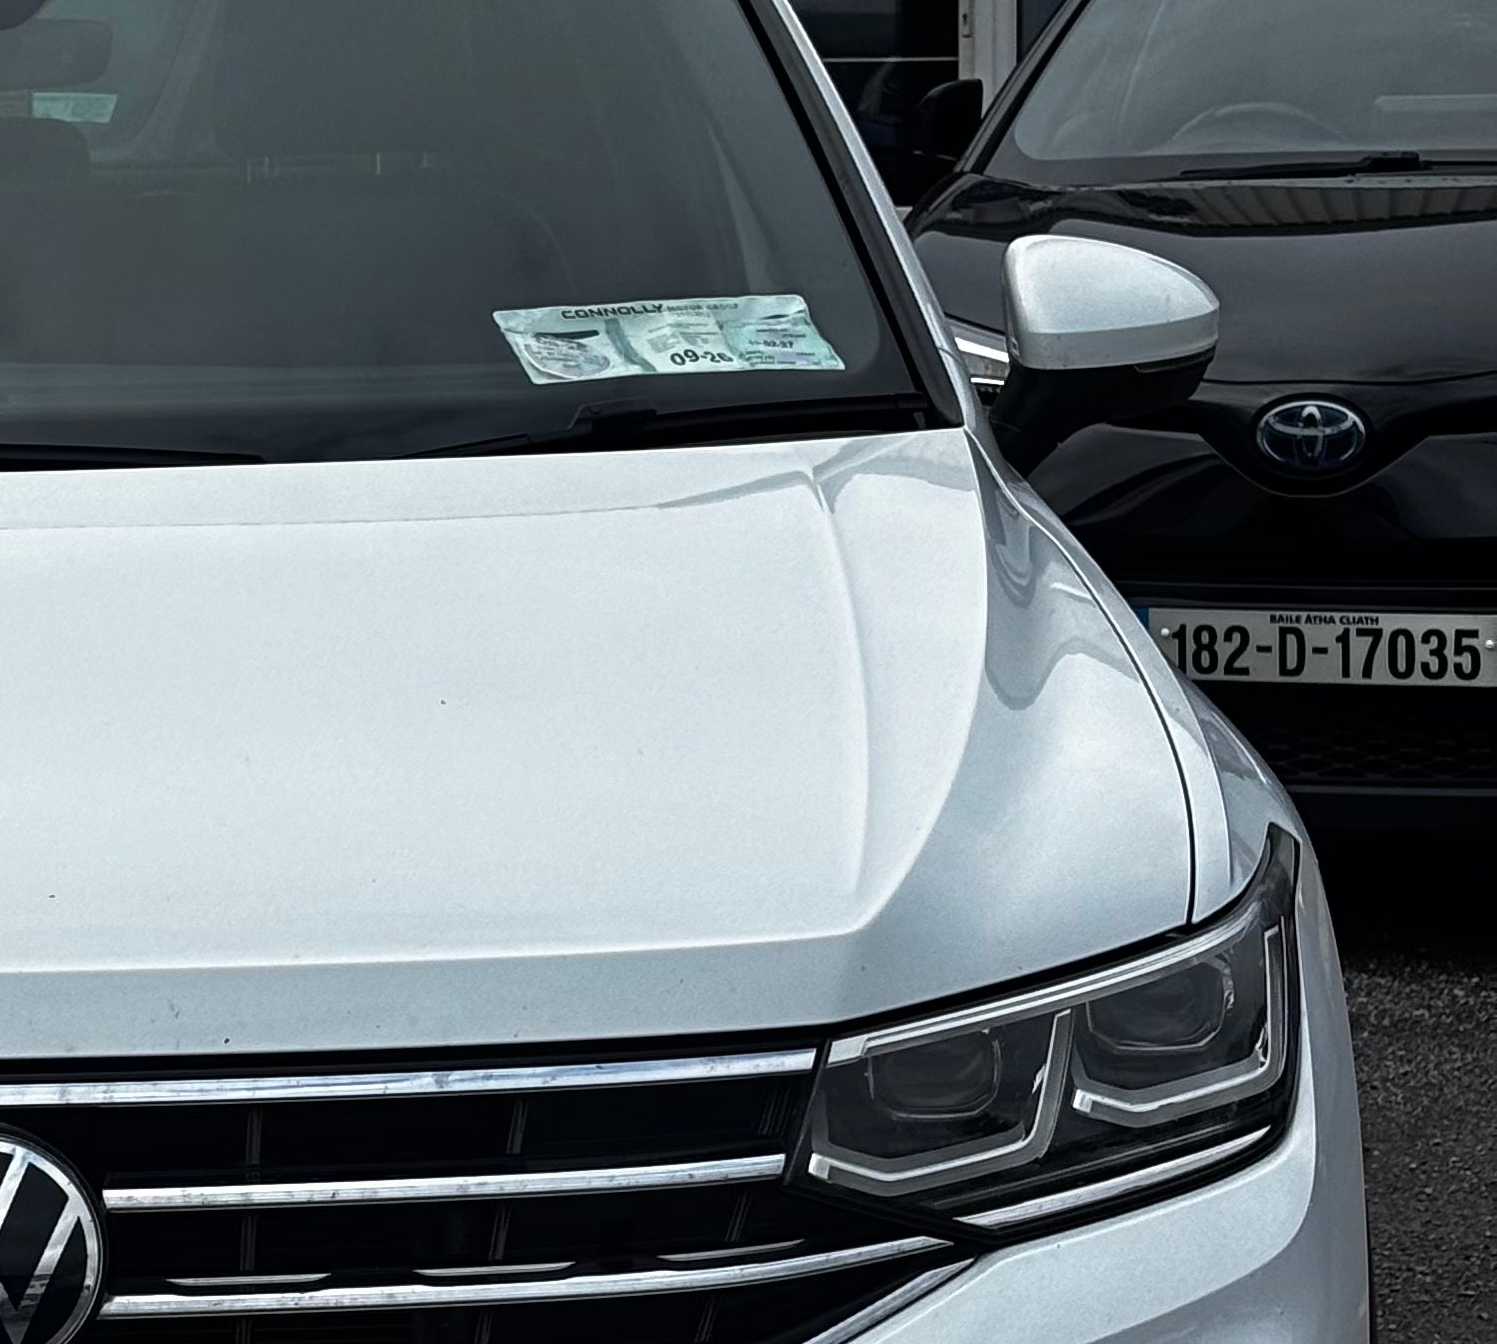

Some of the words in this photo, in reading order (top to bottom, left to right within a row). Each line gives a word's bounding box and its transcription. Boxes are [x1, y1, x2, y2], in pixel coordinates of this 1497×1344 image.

[561, 303, 664, 319] CONNOLLY
[1269, 614, 1301, 624] BAILE
[1339, 615, 1379, 626] CLIATH
[1172, 624, 1481, 681] 182-D-17035
